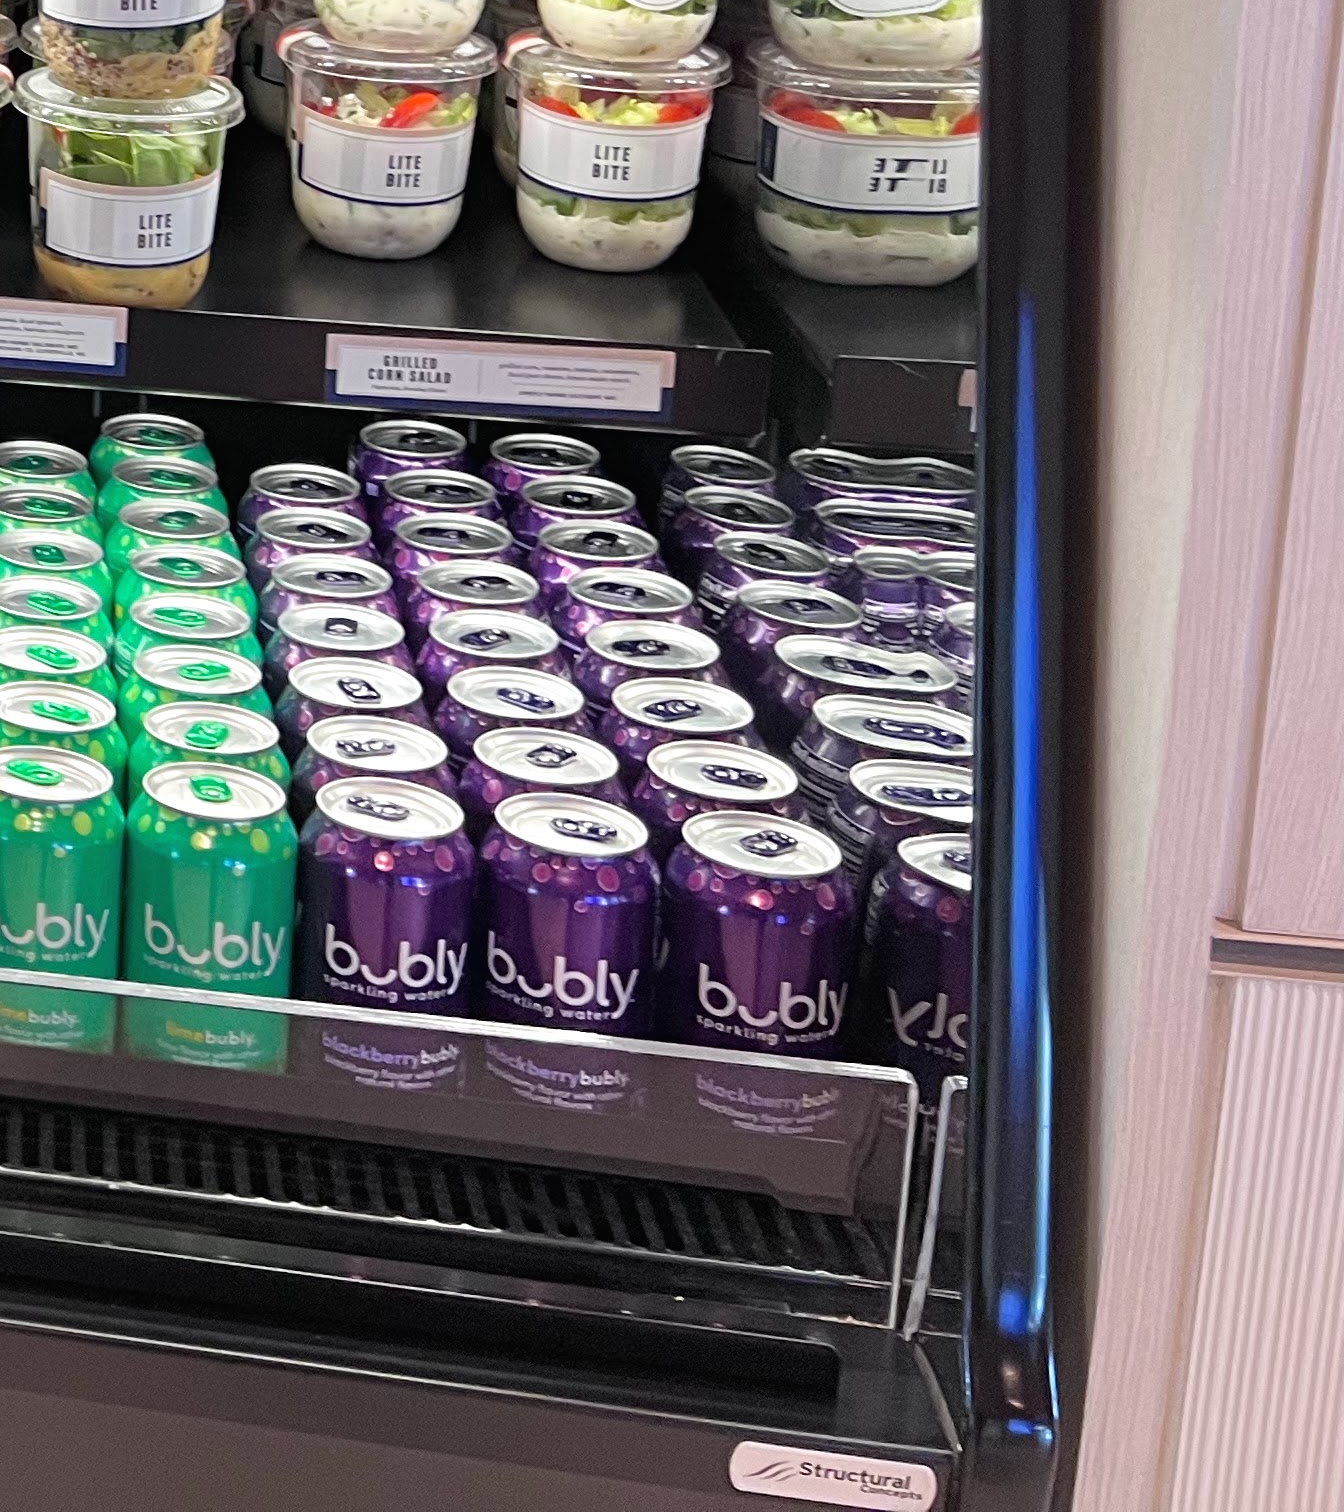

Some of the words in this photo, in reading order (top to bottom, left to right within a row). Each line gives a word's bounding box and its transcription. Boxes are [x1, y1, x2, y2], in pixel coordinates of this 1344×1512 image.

[593, 144, 631, 162] LITE
[387, 155, 422, 170] LITE
[386, 173, 421, 188] BITE
[592, 163, 630, 181] BITE
[138, 213, 172, 230] LITE
[137, 232, 173, 249] BITE
[383, 355, 438, 369] GRILLED
[368, 368, 403, 381] CORN
[409, 370, 451, 384] SALAD
[144, 902, 286, 977] bubly
[325, 923, 468, 995] bubly
[487, 930, 640, 1019] bubly
[323, 974, 399, 1003] sparkling
[404, 989, 449, 1001] water
[699, 963, 848, 1036] bubly
[559, 1008, 612, 1021] water
[696, 1014, 779, 1046] sparkling
[799, 1461, 912, 1491] Structural
